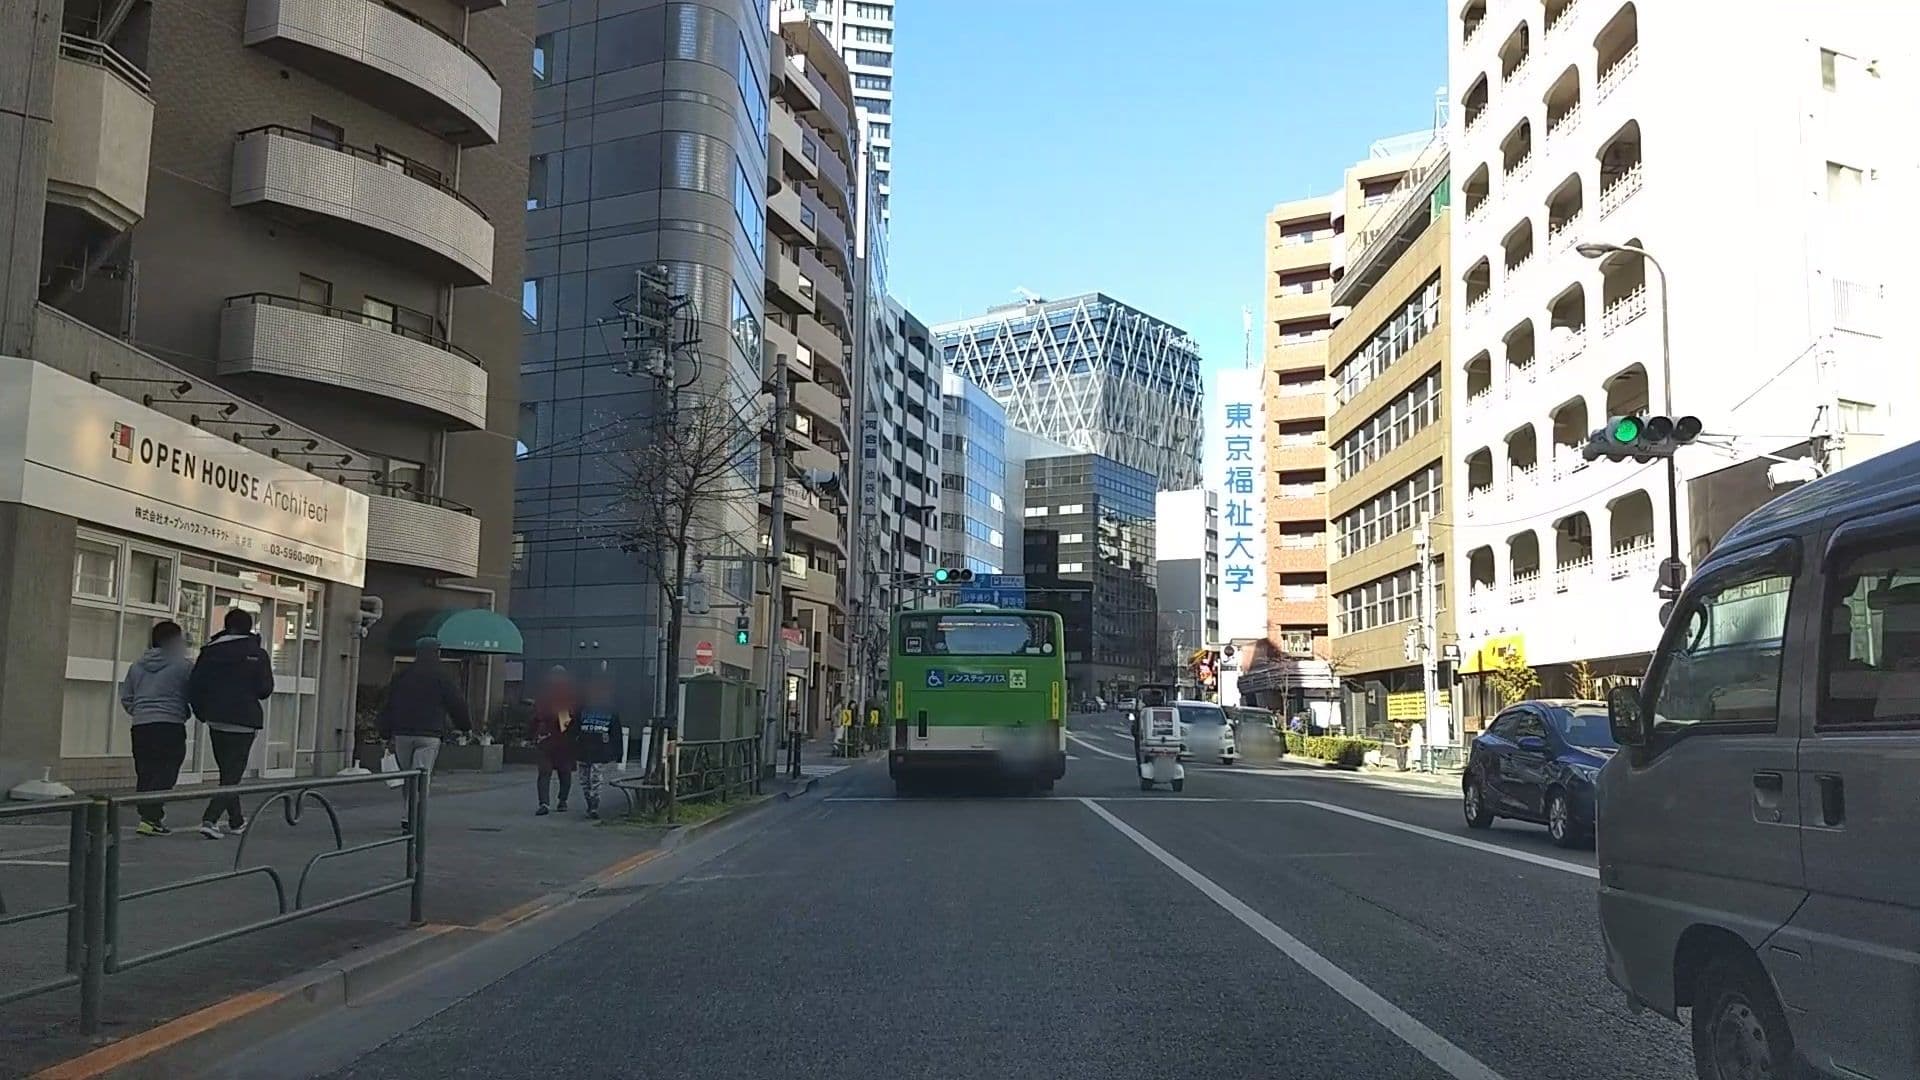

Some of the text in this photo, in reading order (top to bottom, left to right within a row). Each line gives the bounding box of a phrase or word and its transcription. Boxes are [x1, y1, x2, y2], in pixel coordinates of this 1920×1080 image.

[140, 438, 329, 524] OPEN HOUSE Architect
[1224, 402, 1254, 593] 東京福祉大学
[948, 674, 1007, 683] ノンステップバス
